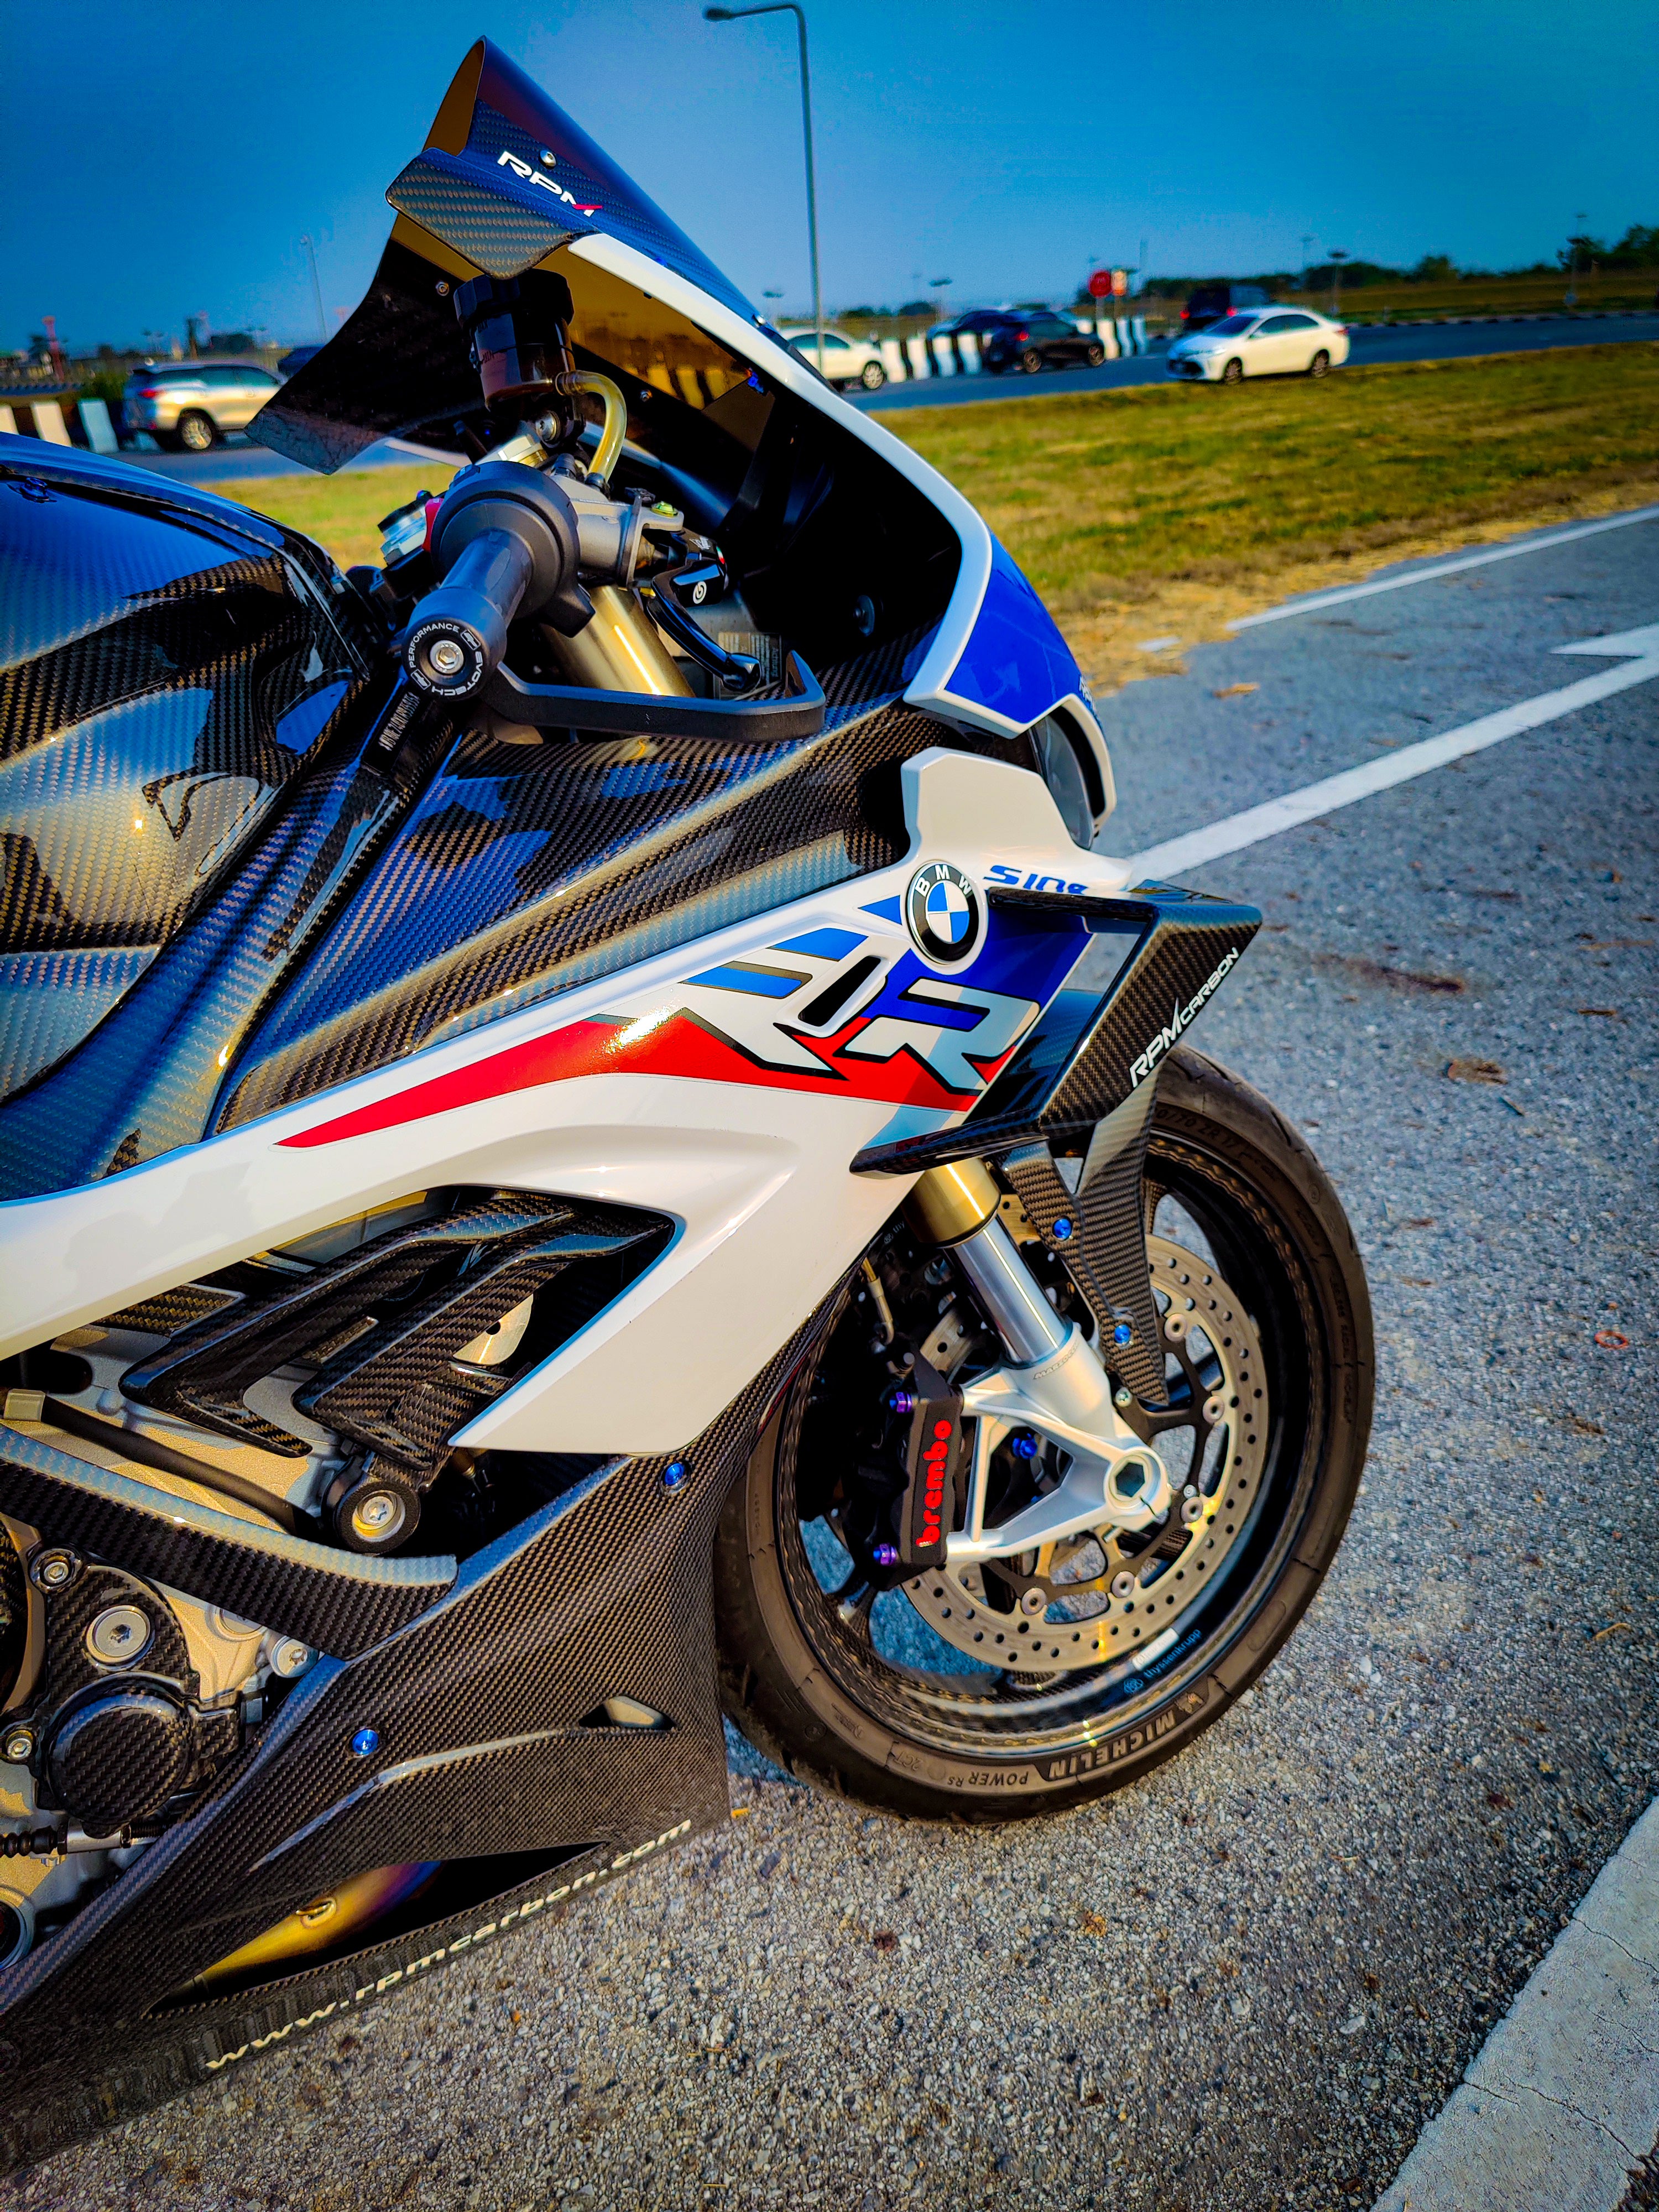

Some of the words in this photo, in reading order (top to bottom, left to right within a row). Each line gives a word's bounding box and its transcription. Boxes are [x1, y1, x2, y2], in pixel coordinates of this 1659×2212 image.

[498, 151, 603, 217] RPM
[409, 623, 460, 668] PERFORMANCE
[431, 651, 483, 696] EVOTECH
[915, 864, 972, 897] BMW
[916, 1420, 952, 1547] brembo
[1049, 1709, 1177, 1779] MICHELIN
[947, 1776, 964, 1787] RS
[968, 1771, 1029, 1787] POWER
[205, 1819, 691, 2069] www.rpmcarbon.com
